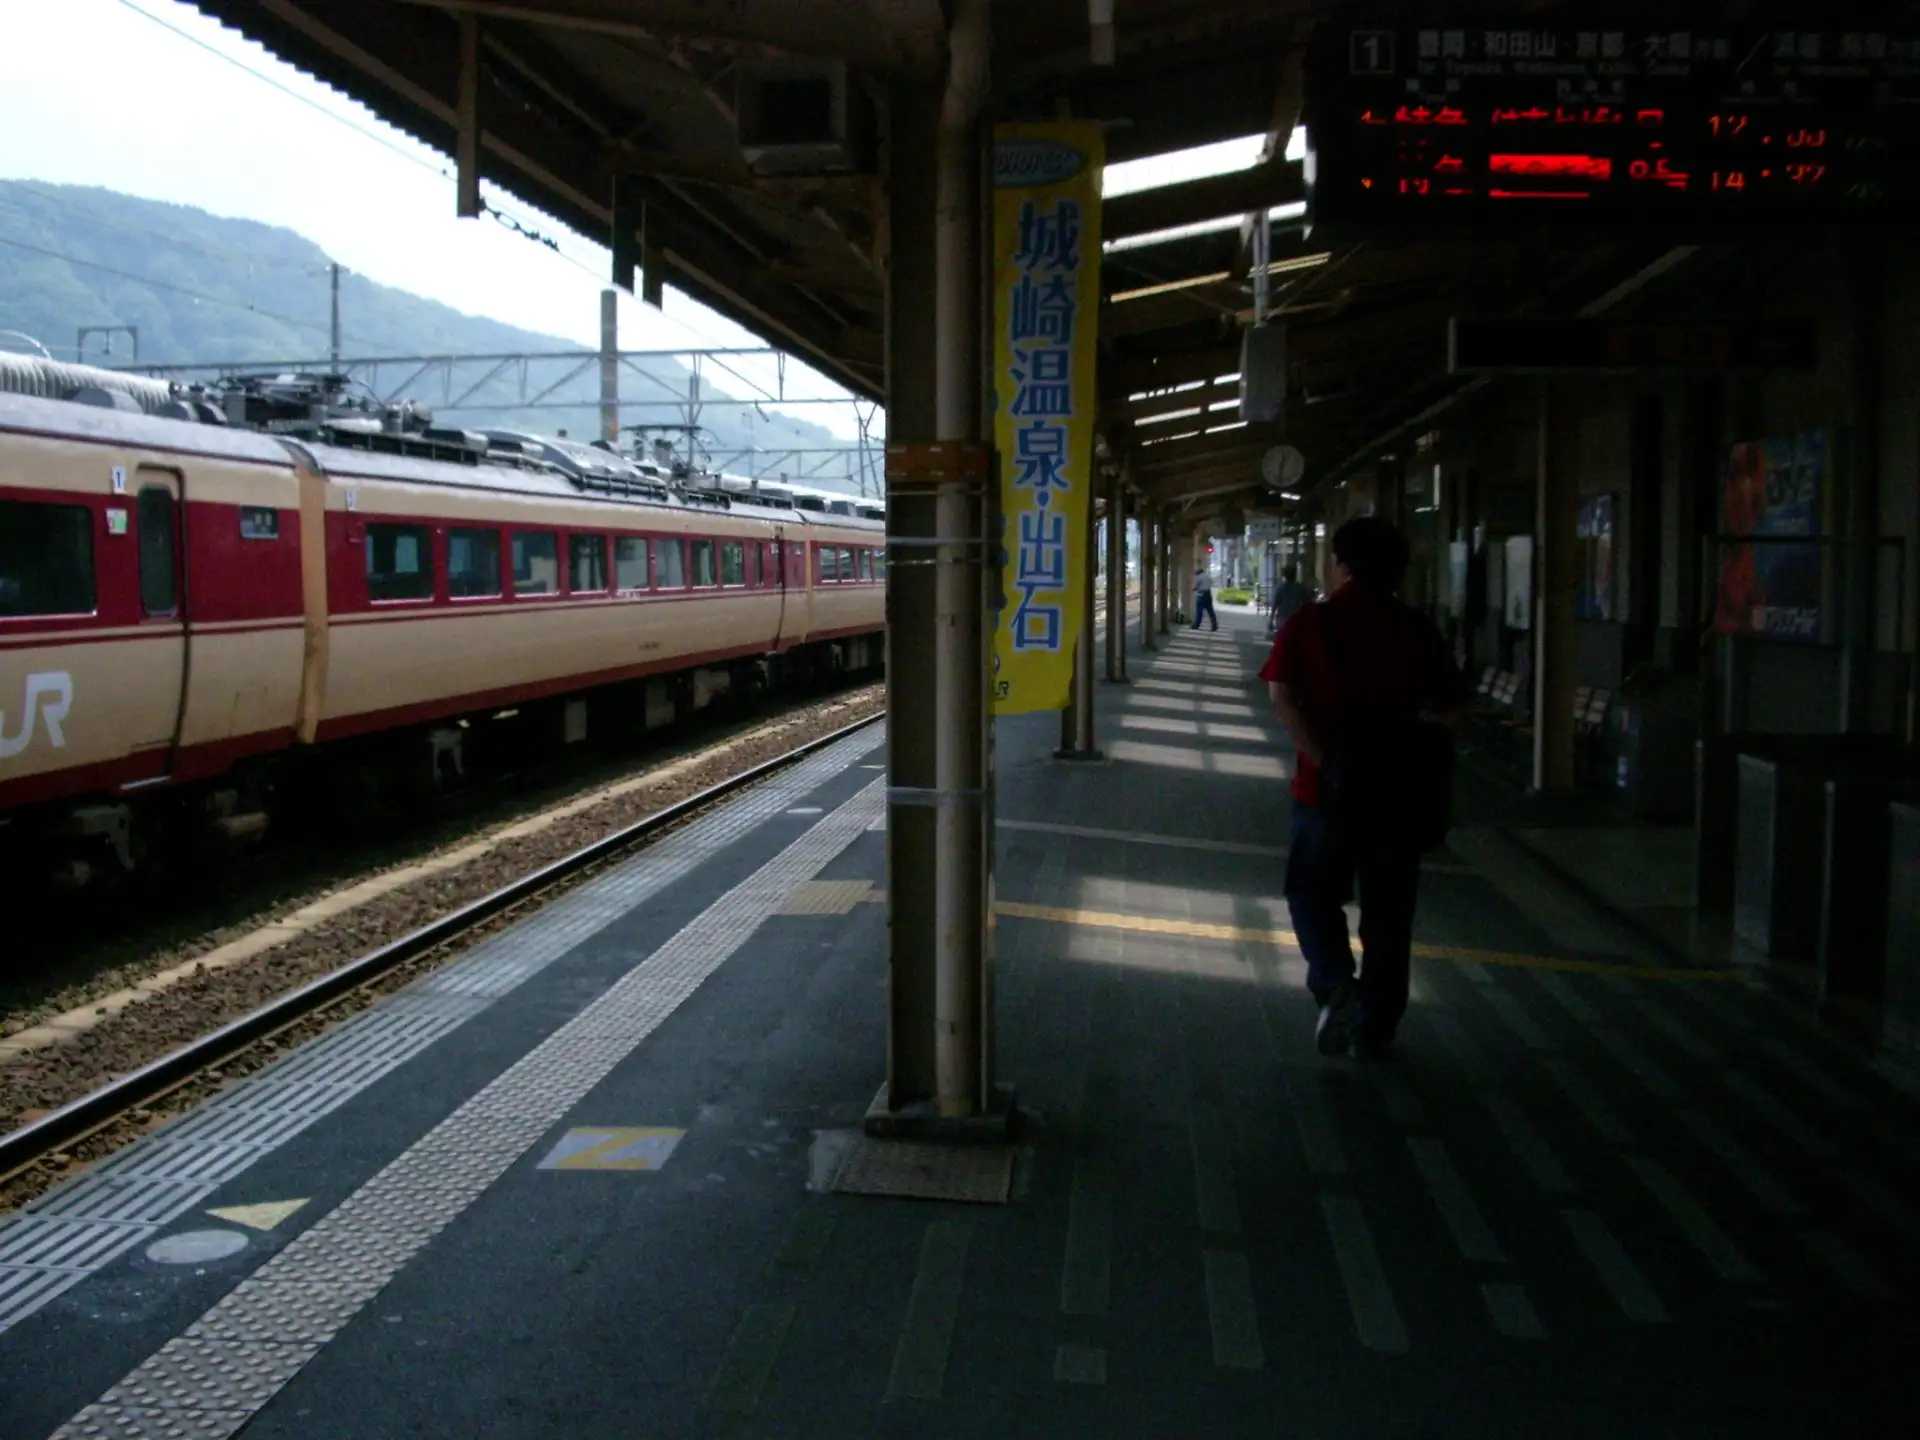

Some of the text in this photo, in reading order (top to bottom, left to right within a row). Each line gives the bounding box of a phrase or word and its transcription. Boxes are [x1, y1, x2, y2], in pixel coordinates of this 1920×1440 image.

[1362, 36, 1378, 70] 1
[1012, 203, 1079, 648] 城崎温泉・出石
[0, 671, 73, 758] JR
